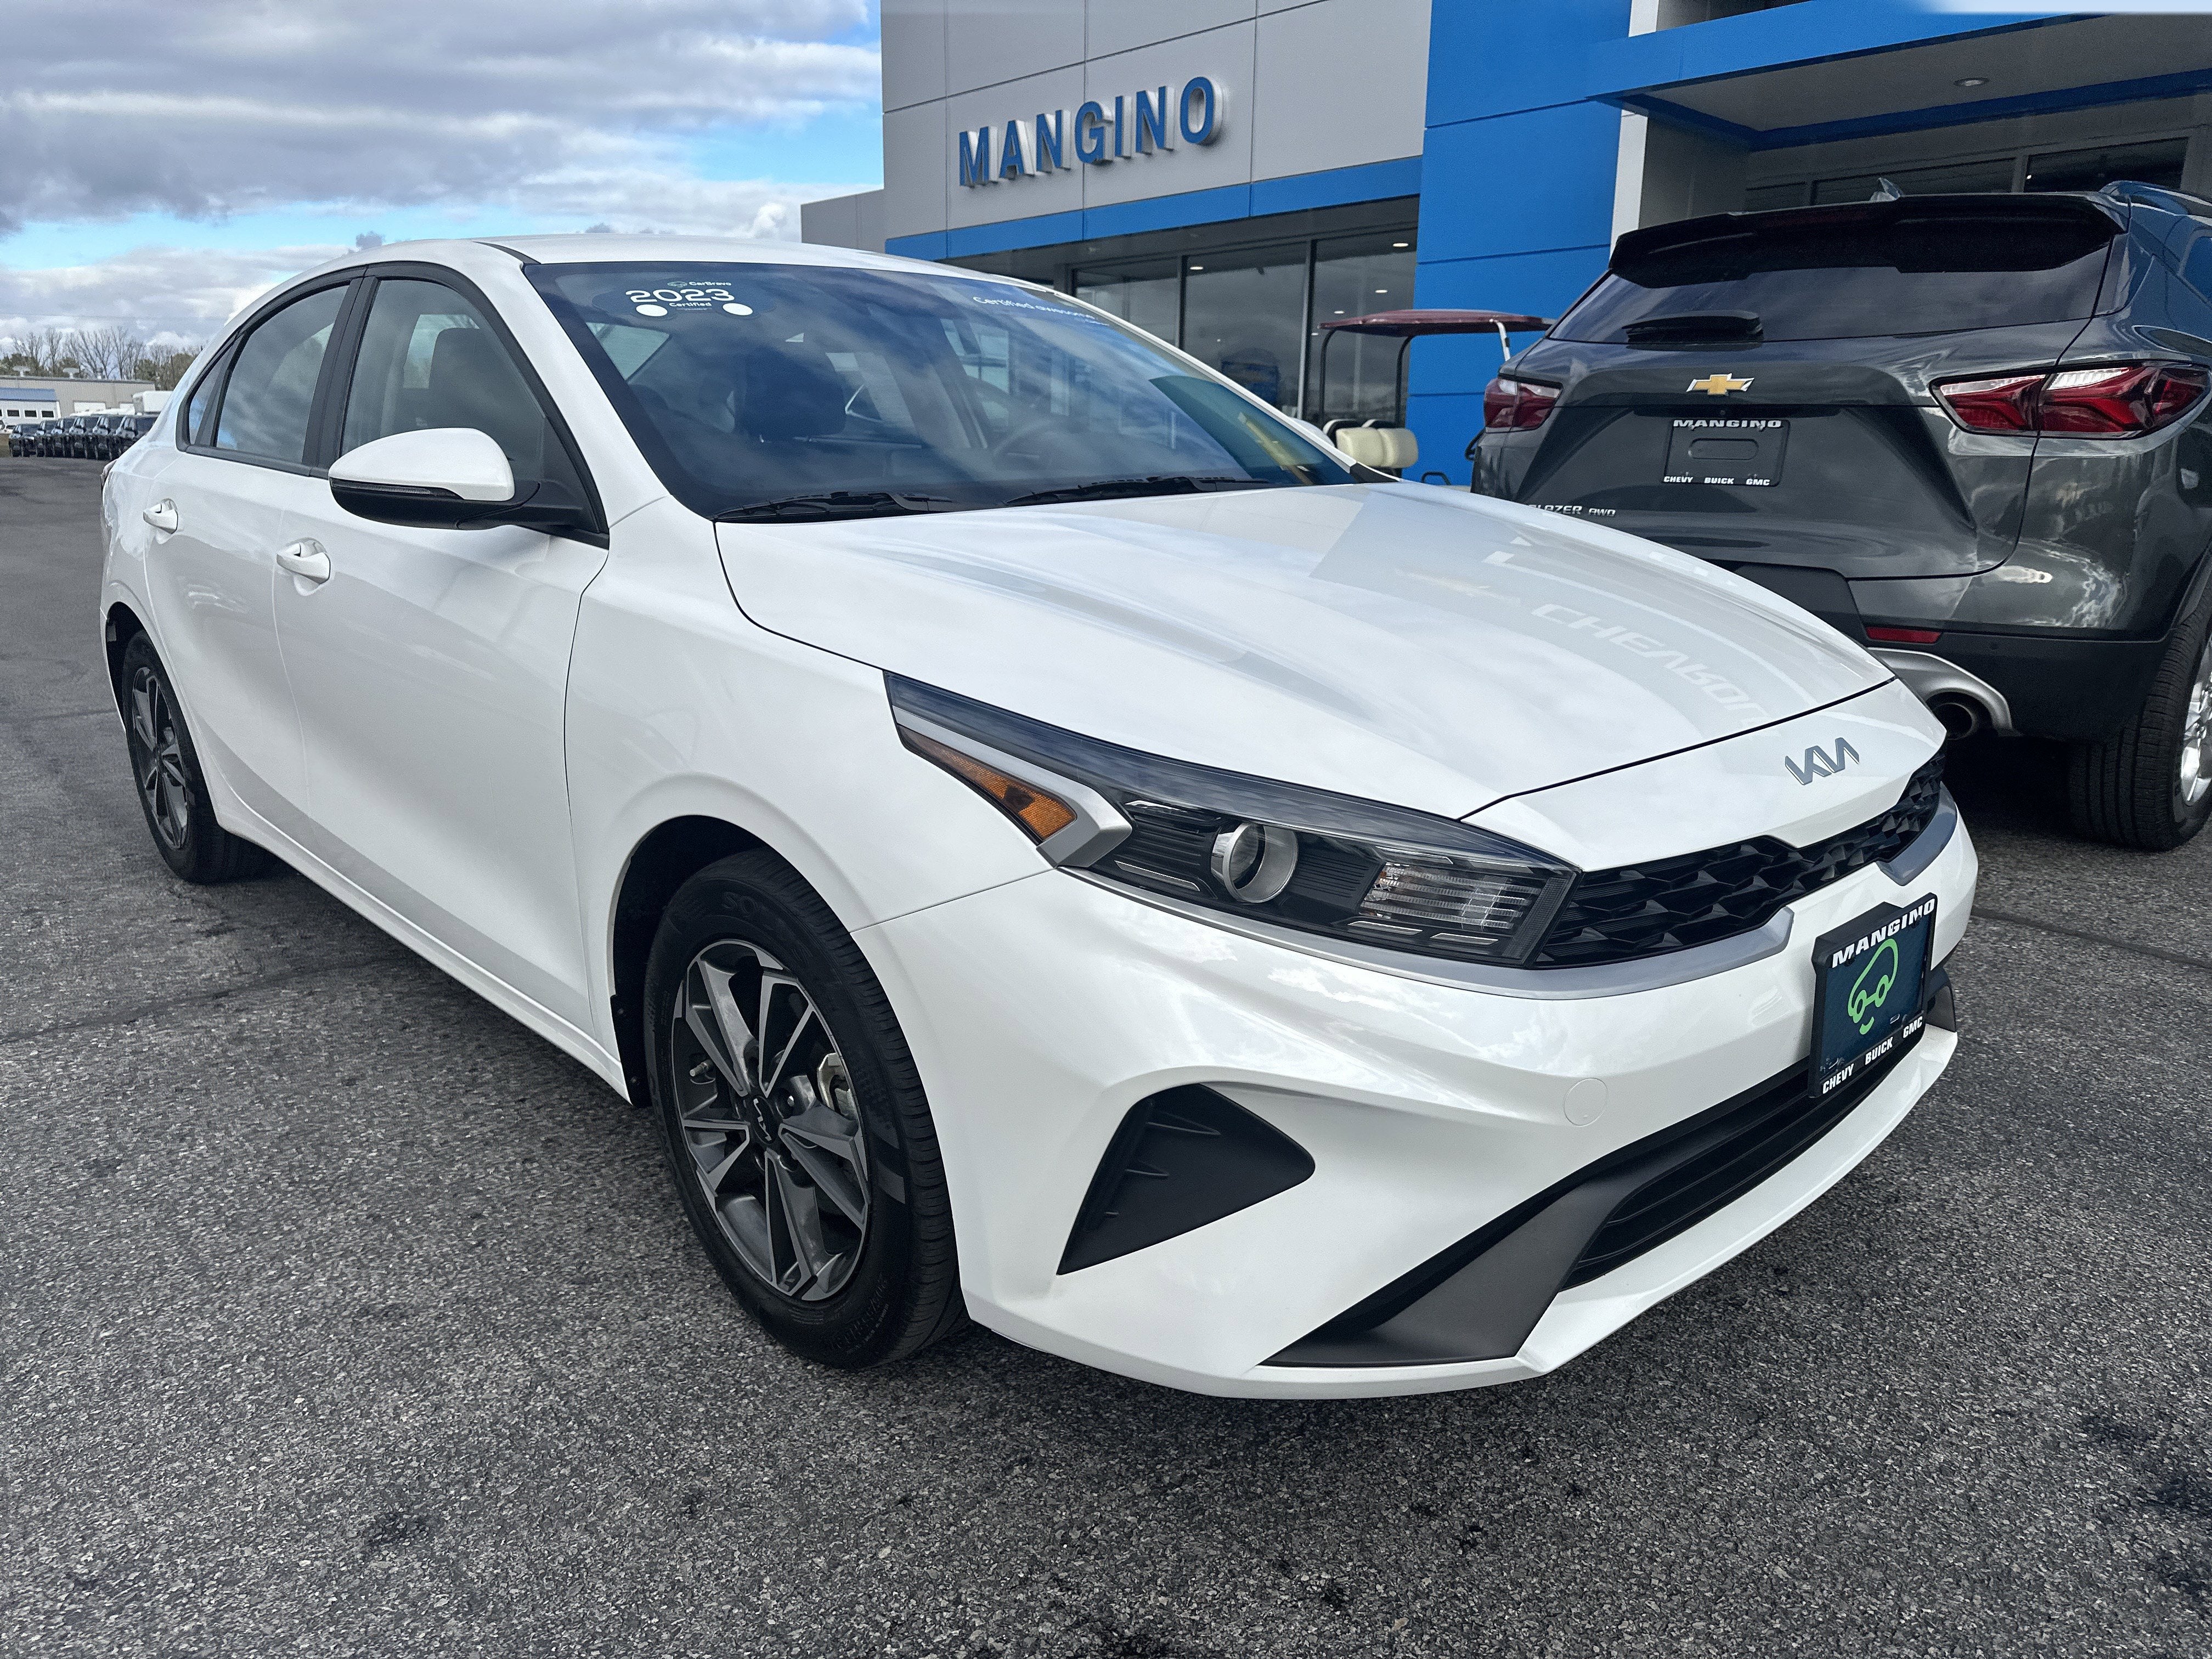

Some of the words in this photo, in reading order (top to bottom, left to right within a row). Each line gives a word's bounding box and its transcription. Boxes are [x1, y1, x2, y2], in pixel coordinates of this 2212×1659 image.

[960, 76, 1220, 187] MANGINO
[625, 289, 735, 303] 2023
[973, 296, 1035, 309] Certified
[1673, 420, 1782, 428] MANGINO
[1588, 507, 1616, 517] AWD
[1832, 898, 1936, 968] MANGINO
[1822, 1063, 1854, 1094] CHEVY
[1865, 1036, 1893, 1065] BUICK
[1903, 1015, 1923, 1039] GMC
